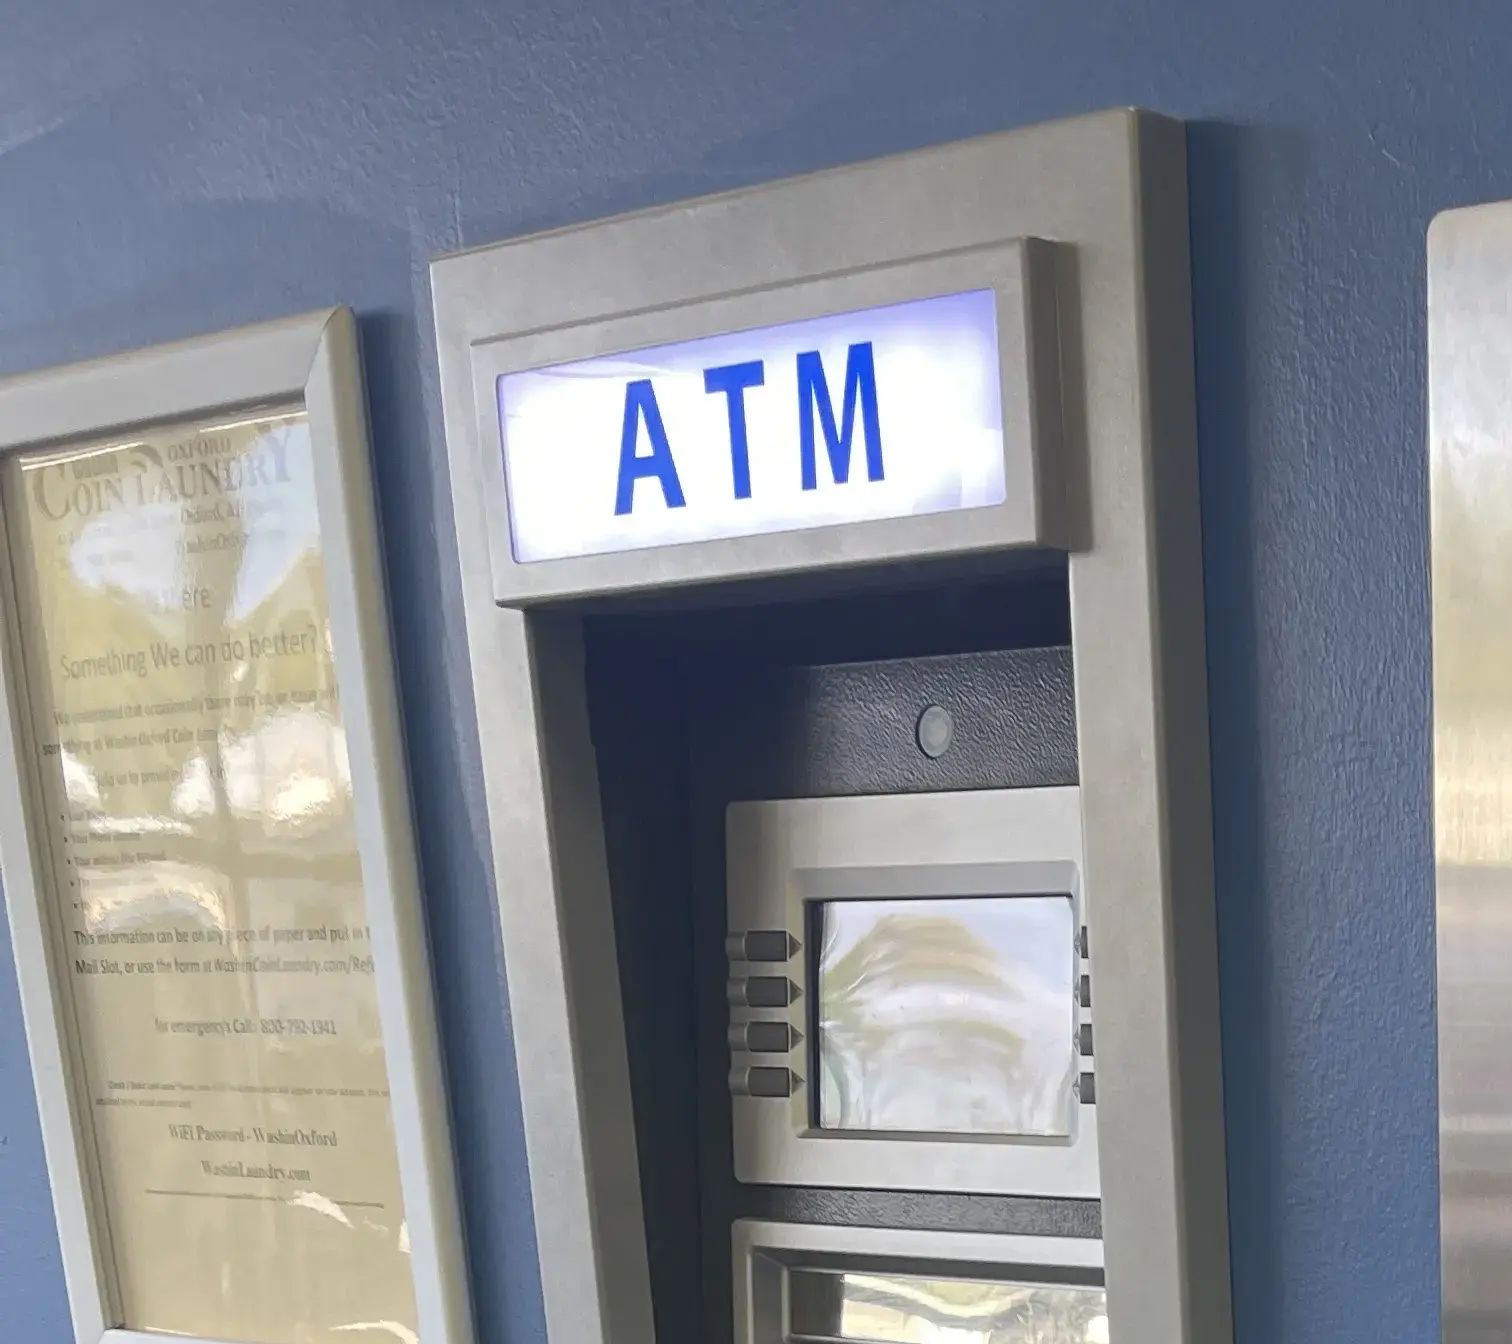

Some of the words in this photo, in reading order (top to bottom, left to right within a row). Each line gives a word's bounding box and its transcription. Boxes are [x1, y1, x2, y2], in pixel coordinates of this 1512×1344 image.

[614, 341, 884, 515] ATM
[61, 648, 148, 680] Something
[151, 642, 180, 668] We
[185, 643, 216, 664] can
[249, 625, 317, 659] better?
[73, 930, 95, 944] This
[175, 927, 188, 943] be
[76, 960, 98, 974] Mail
